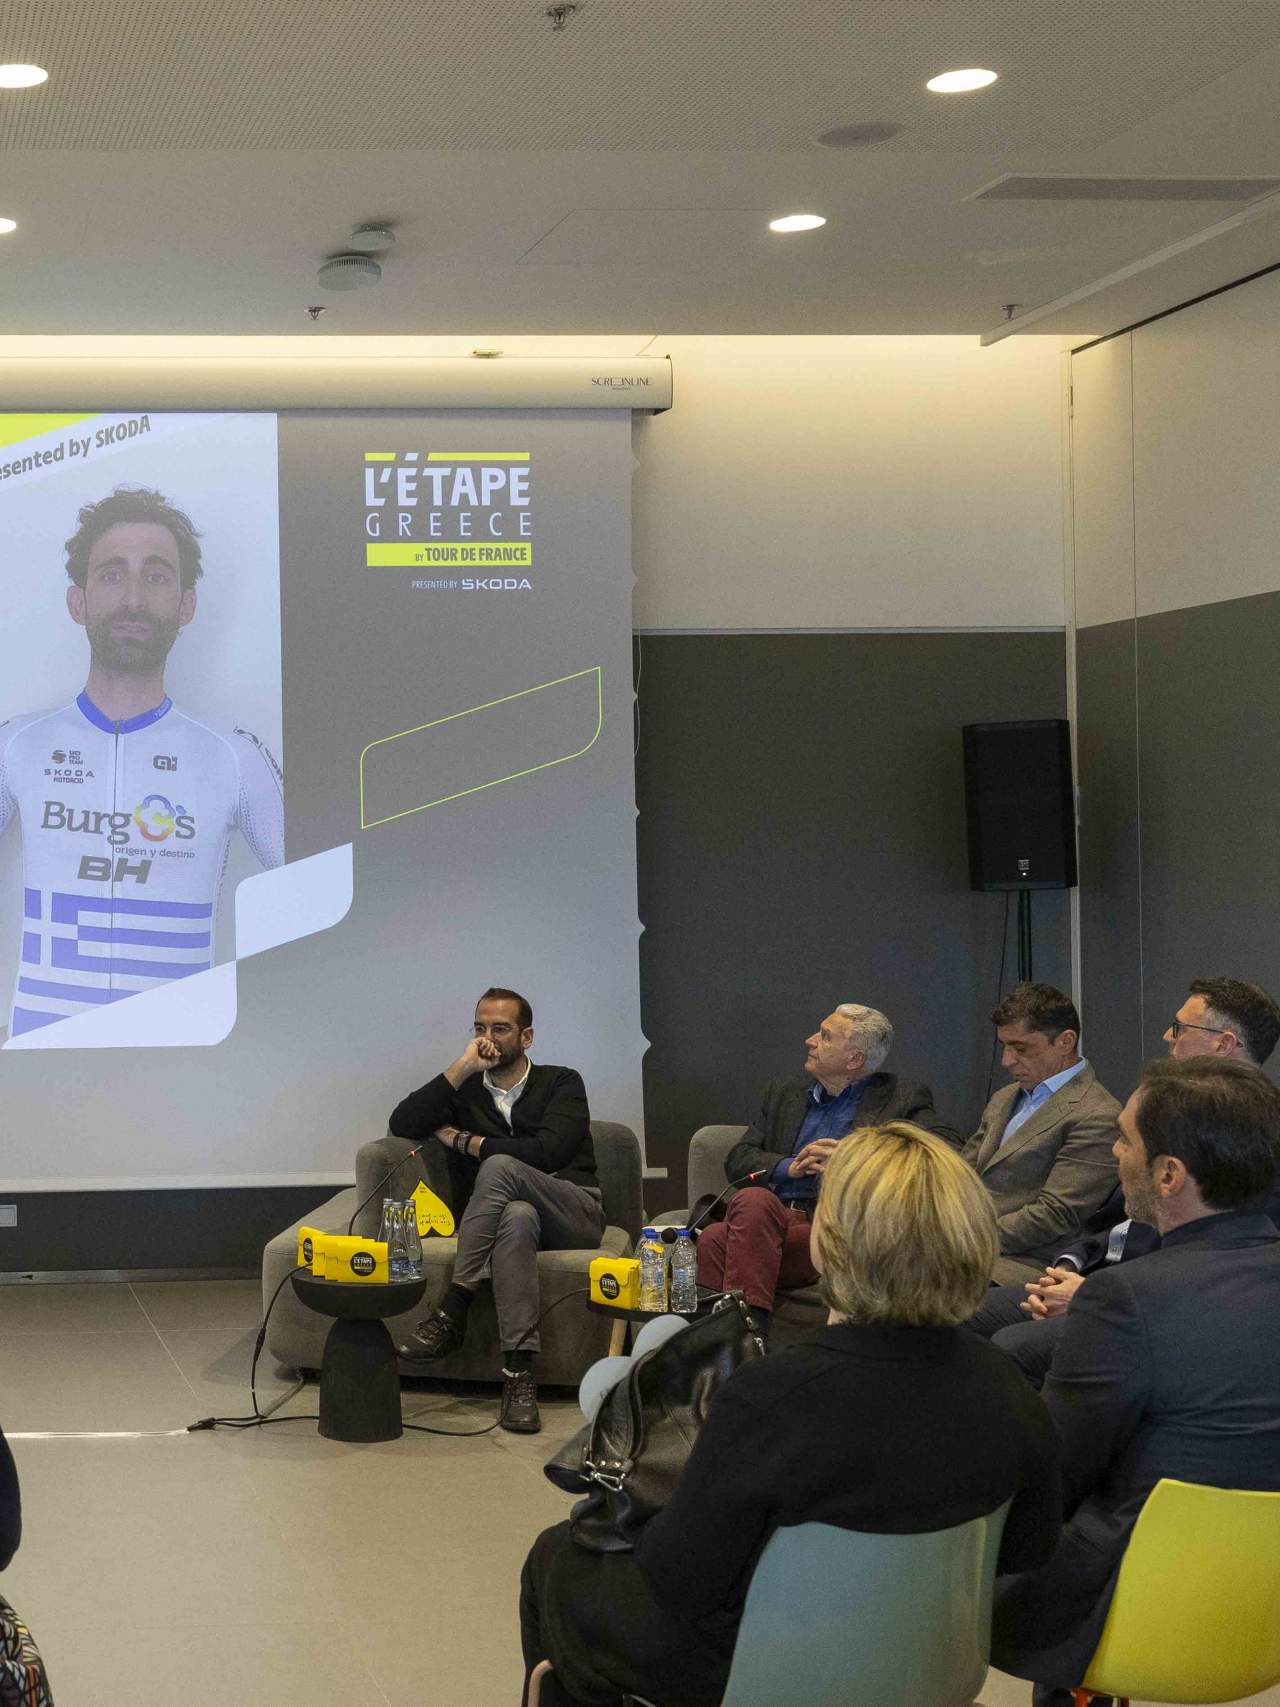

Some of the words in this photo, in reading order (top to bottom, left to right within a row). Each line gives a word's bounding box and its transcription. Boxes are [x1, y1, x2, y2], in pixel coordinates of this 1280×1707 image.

[69, 435, 91, 457] by
[95, 414, 151, 449] SKODA
[365, 453, 530, 506] L'ÉTAPE
[366, 512, 531, 536] GREECE
[415, 553, 424, 561] BY
[425, 547, 458, 561] TOUR
[461, 547, 476, 561] DE
[479, 547, 527, 561] FRANCE
[462, 578, 532, 590] SKODA
[40, 794, 196, 845] Burgos
[115, 847, 147, 857] origen
[150, 850, 157, 858] y
[160, 849, 195, 859] destino
[77, 855, 152, 884] BH
